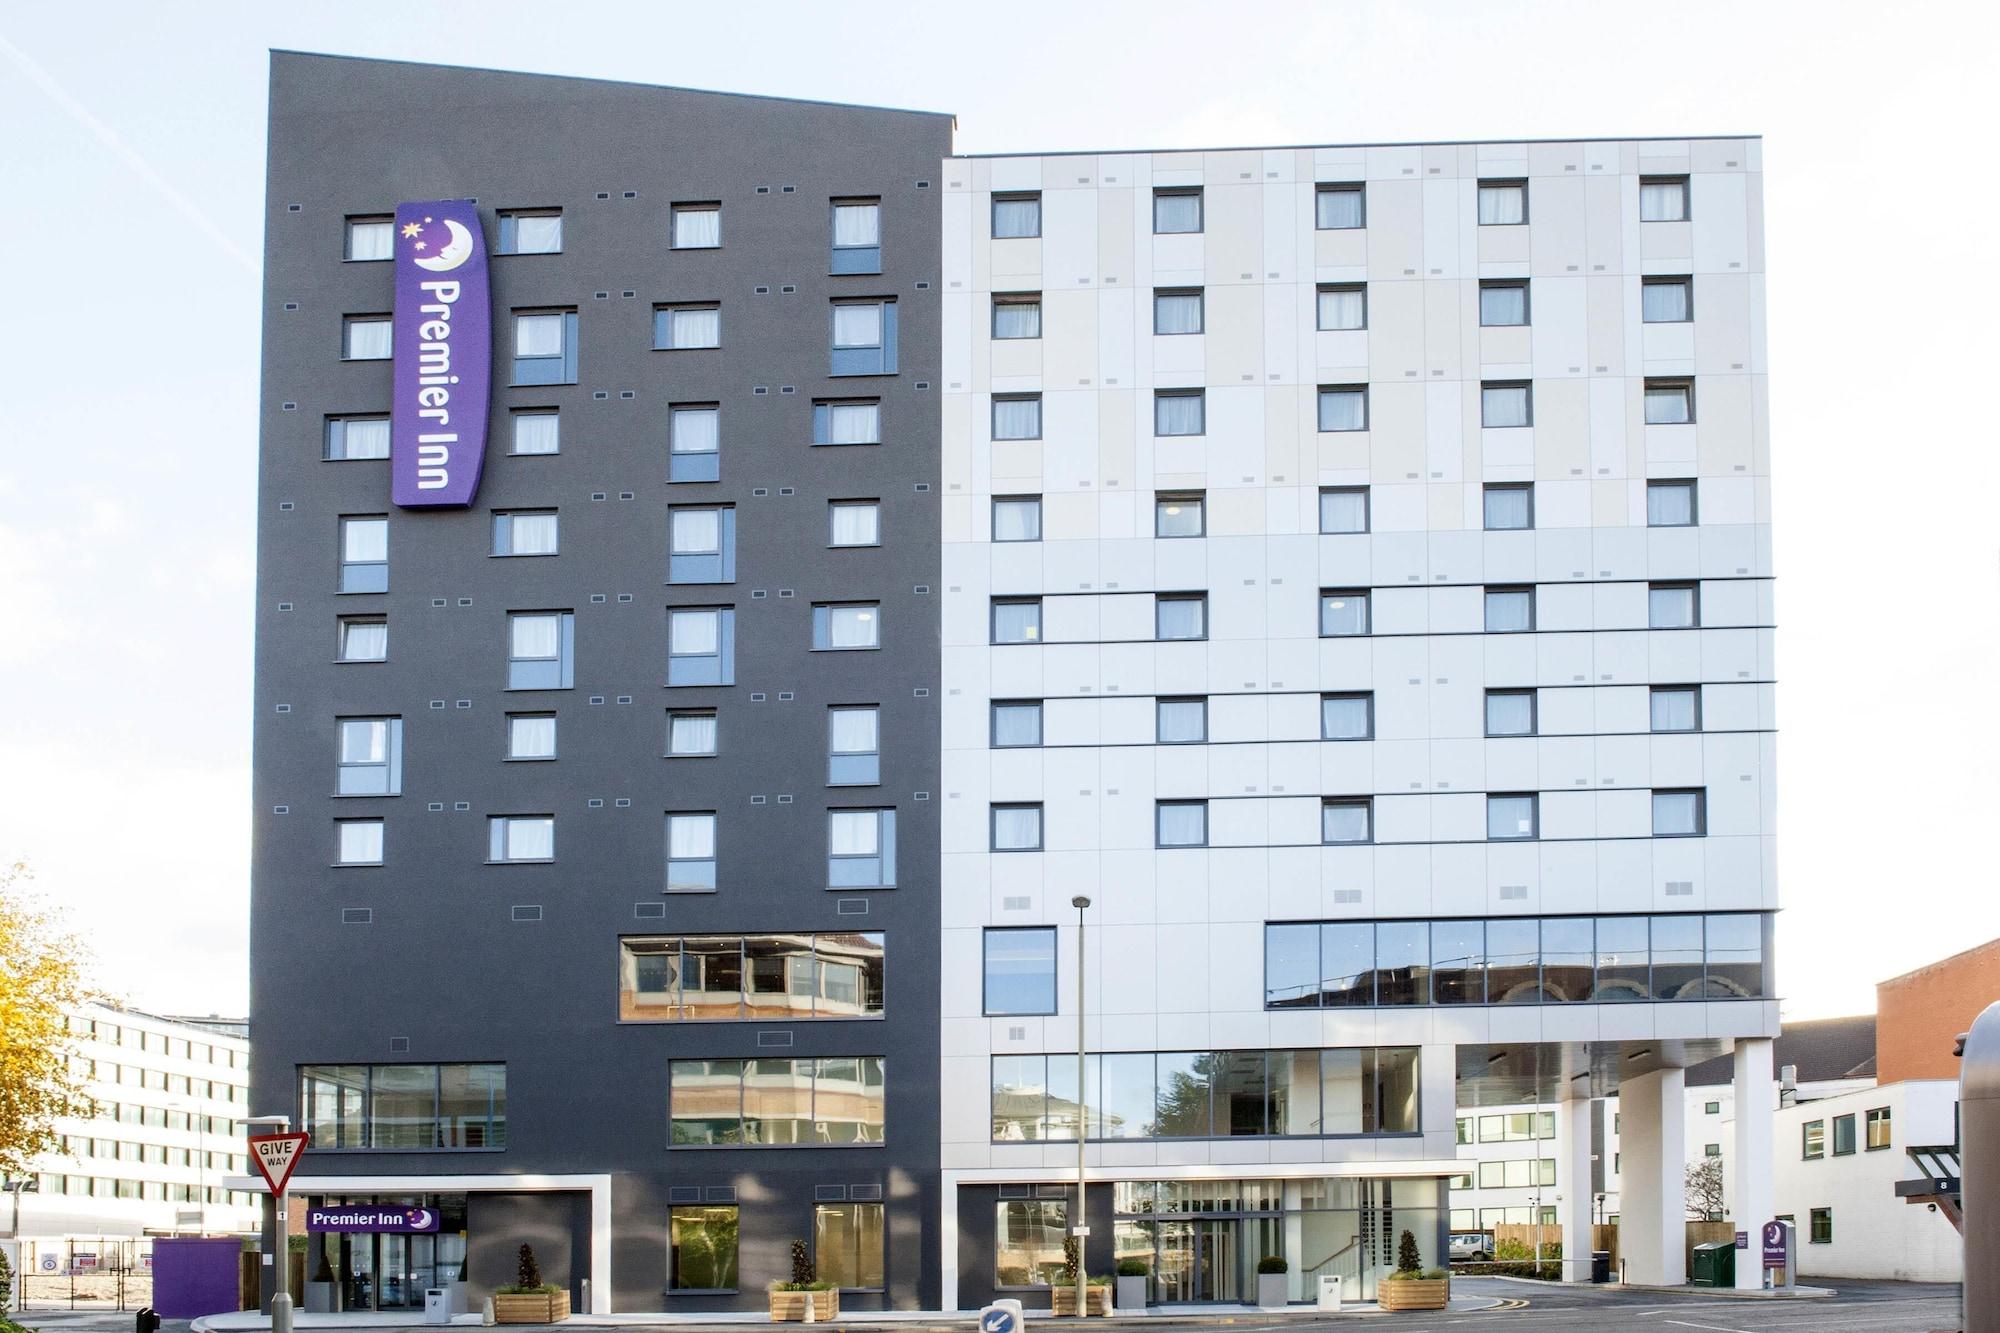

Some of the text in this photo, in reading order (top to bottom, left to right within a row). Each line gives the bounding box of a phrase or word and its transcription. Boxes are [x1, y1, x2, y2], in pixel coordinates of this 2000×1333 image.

[417, 280, 460, 490] Premier Inn
[260, 1142, 292, 1155] GIVE
[267, 1157, 288, 1166] WAY
[1940, 1181, 1947, 1189] 8
[312, 1213, 403, 1225] Premier Inn
